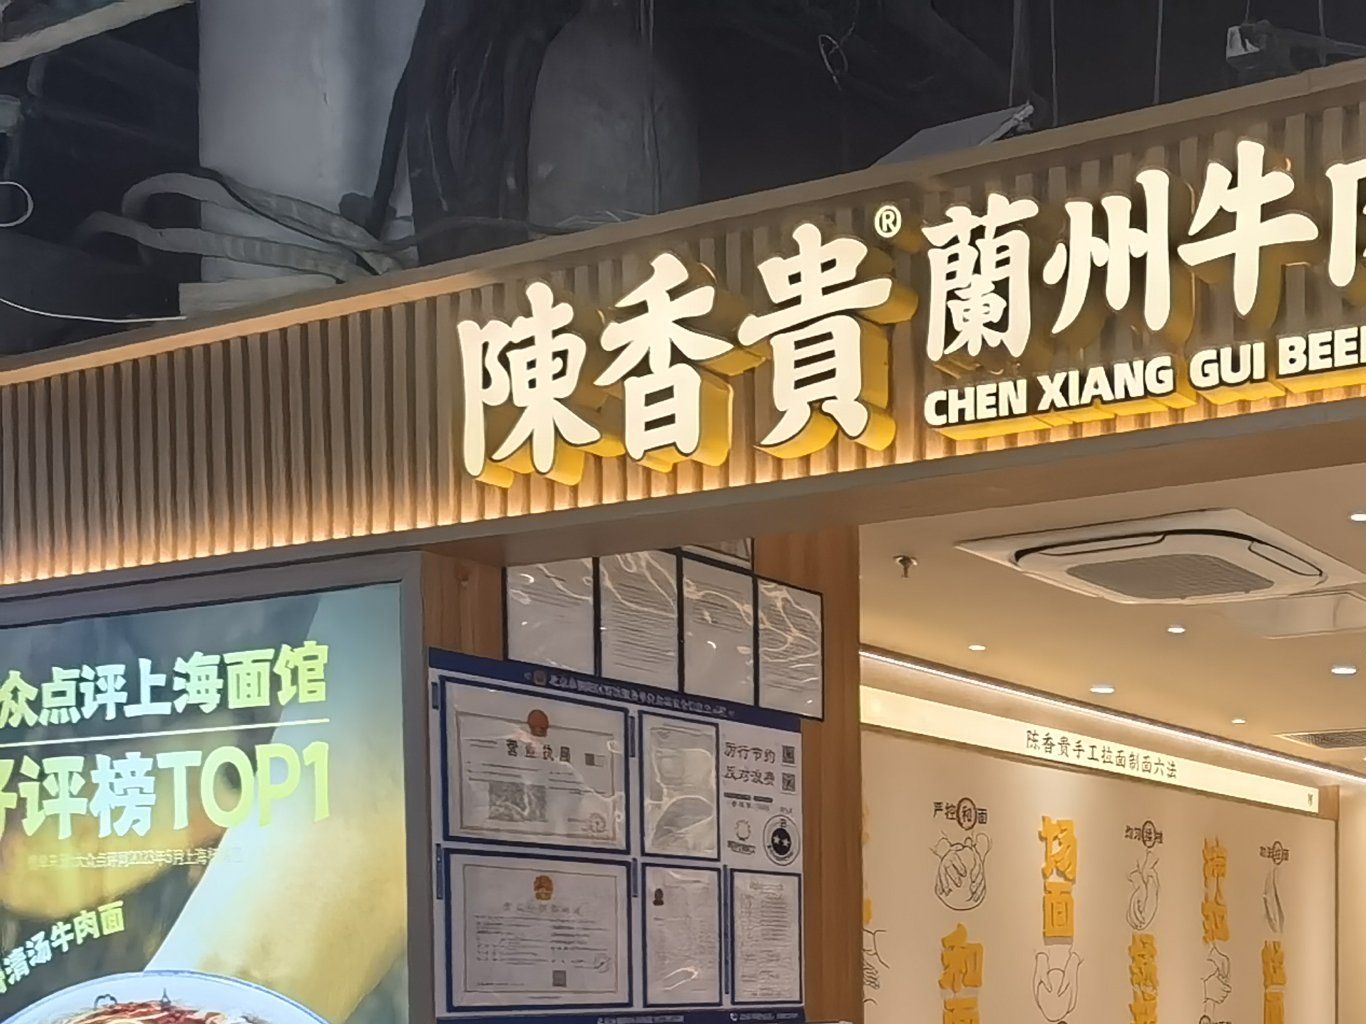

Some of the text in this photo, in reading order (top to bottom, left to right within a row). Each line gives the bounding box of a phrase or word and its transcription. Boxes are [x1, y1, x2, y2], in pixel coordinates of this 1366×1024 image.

[457, 223, 893, 478] 陳香貴
[923, 380, 1027, 427] CHEN
[1036, 356, 1174, 413] XIANG
[1189, 343, 1265, 389] GUI
[0, 641, 329, 728] 众点评上海面馆
[1026, 729, 1178, 779] 陈香贵手工拉面制面六法
[0, 900, 125, 994] 清汤牛肉面
